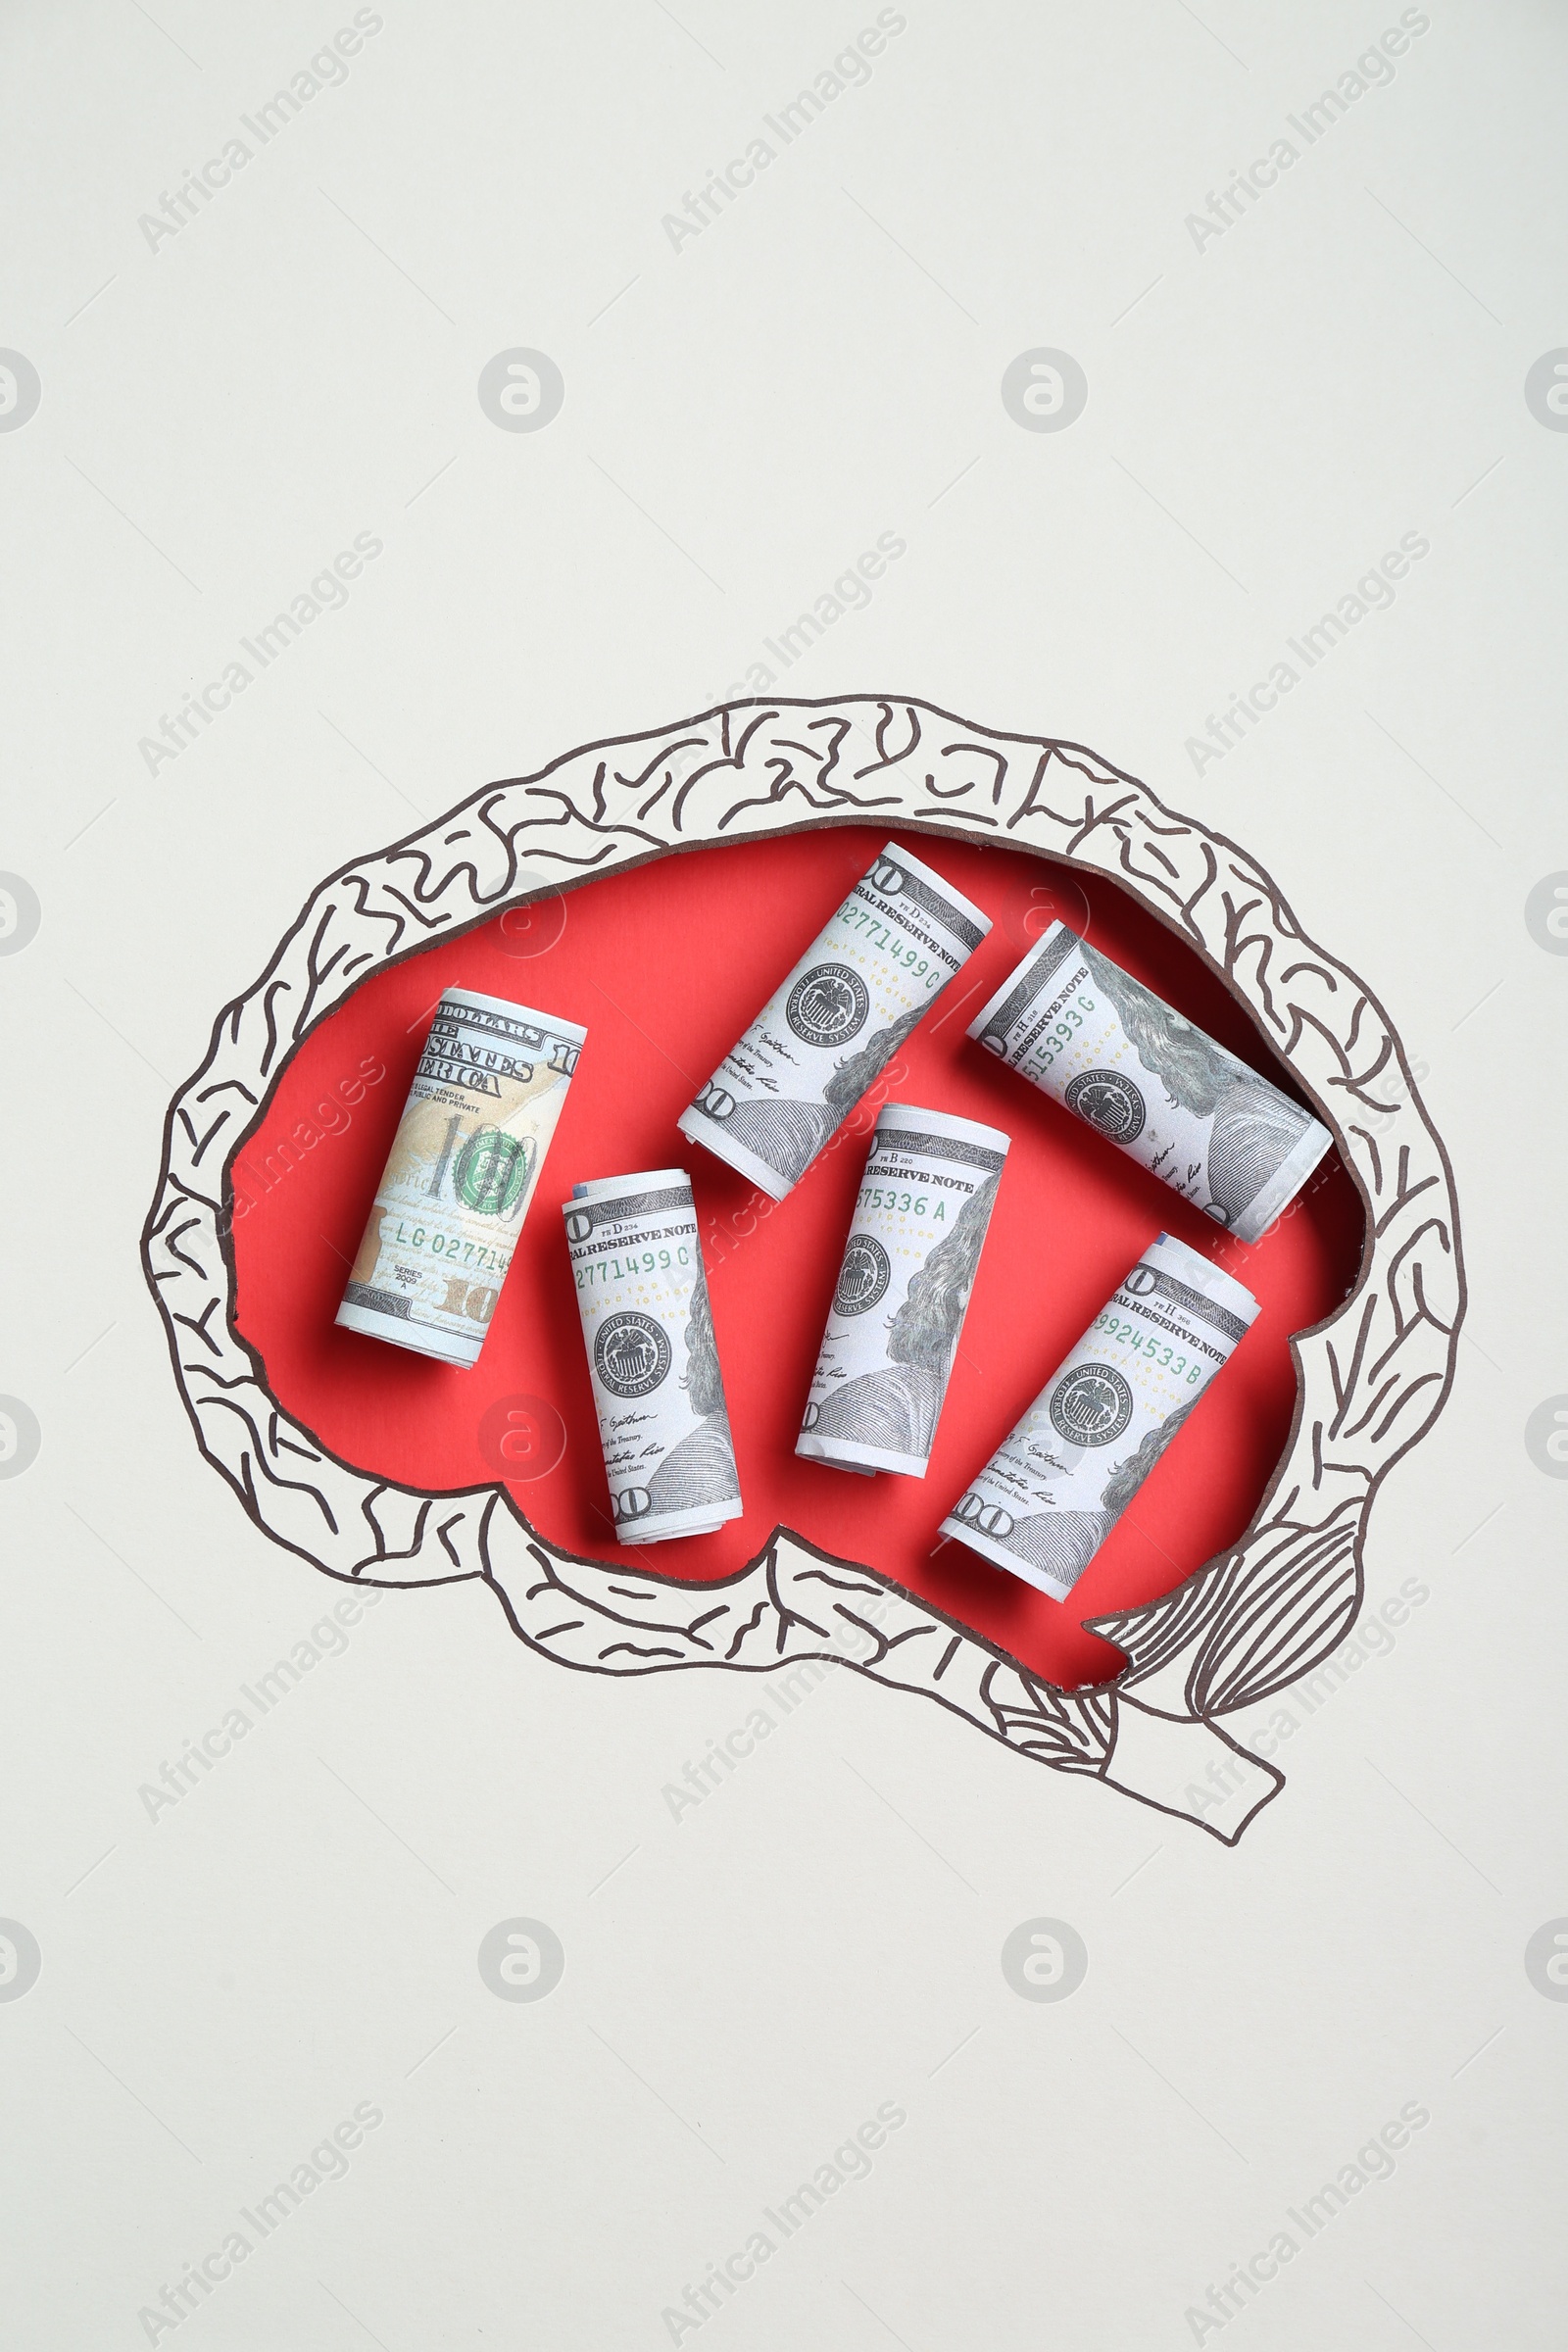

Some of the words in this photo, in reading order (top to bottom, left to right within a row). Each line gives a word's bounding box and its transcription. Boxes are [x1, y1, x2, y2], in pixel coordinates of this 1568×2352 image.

[907, 906, 922, 920] D
[835, 900, 930, 980] 02771499
[925, 970, 940, 989] C
[873, 898, 940, 954] RESERVE
[936, 947, 961, 973] NOTE
[791, 978, 808, 1013] FEDERAL
[816, 967, 849, 980] UNITED
[848, 977, 863, 1008] STATES
[441, 1004, 540, 1043] DOLLARS
[1010, 1000, 1062, 1061] RESERVE
[1055, 965, 1090, 1004] NOTE
[1015, 1019, 1030, 1033] H
[792, 1015, 824, 1042] RESERVE
[828, 1016, 860, 1042] SYSTEM
[1020, 1007, 1085, 1082] 515393
[1076, 995, 1096, 1011] G
[426, 1034, 535, 1084] STATES
[1077, 1073, 1105, 1086] STATES
[1114, 1077, 1140, 1108] SYSTEM
[431, 1094, 448, 1104] AND
[447, 1099, 481, 1114] PRIVATE
[434, 1087, 466, 1102] TENDER
[1119, 1114, 1139, 1140] RESERVE
[888, 1152, 899, 1163] B
[865, 1164, 930, 1183] RESERVE
[930, 1174, 975, 1194] NOTE
[932, 1200, 948, 1221] A
[395, 1221, 427, 1249] LG
[585, 1229, 662, 1255] RESERVE
[662, 1223, 697, 1238] NOTE
[612, 1222, 623, 1234] D
[862, 1240, 883, 1260] STATES
[392, 1264, 423, 1279] SERIES
[394, 1272, 417, 1285] 2009
[575, 1249, 671, 1289] 2771499
[677, 1246, 688, 1265] C
[400, 1281, 408, 1290] A
[864, 1270, 886, 1304] SYSTEM
[1162, 1302, 1177, 1317] H
[598, 1317, 623, 1344] UNITED
[625, 1316, 656, 1332] STATES
[1129, 1300, 1200, 1348] RESERVE
[1197, 1341, 1227, 1366] NOTE
[597, 1353, 615, 1388] FEDERAL
[617, 1377, 655, 1393] RESERVE
[655, 1337, 666, 1376] SYSTEM
[1185, 1363, 1202, 1386] B
[1054, 1381, 1068, 1416] FEDERAL
[1076, 1369, 1108, 1378] UNITED
[1109, 1375, 1127, 1403] STATES
[1057, 1420, 1091, 1442] RESERVE
[1096, 1413, 1126, 1442] SYSTEM
